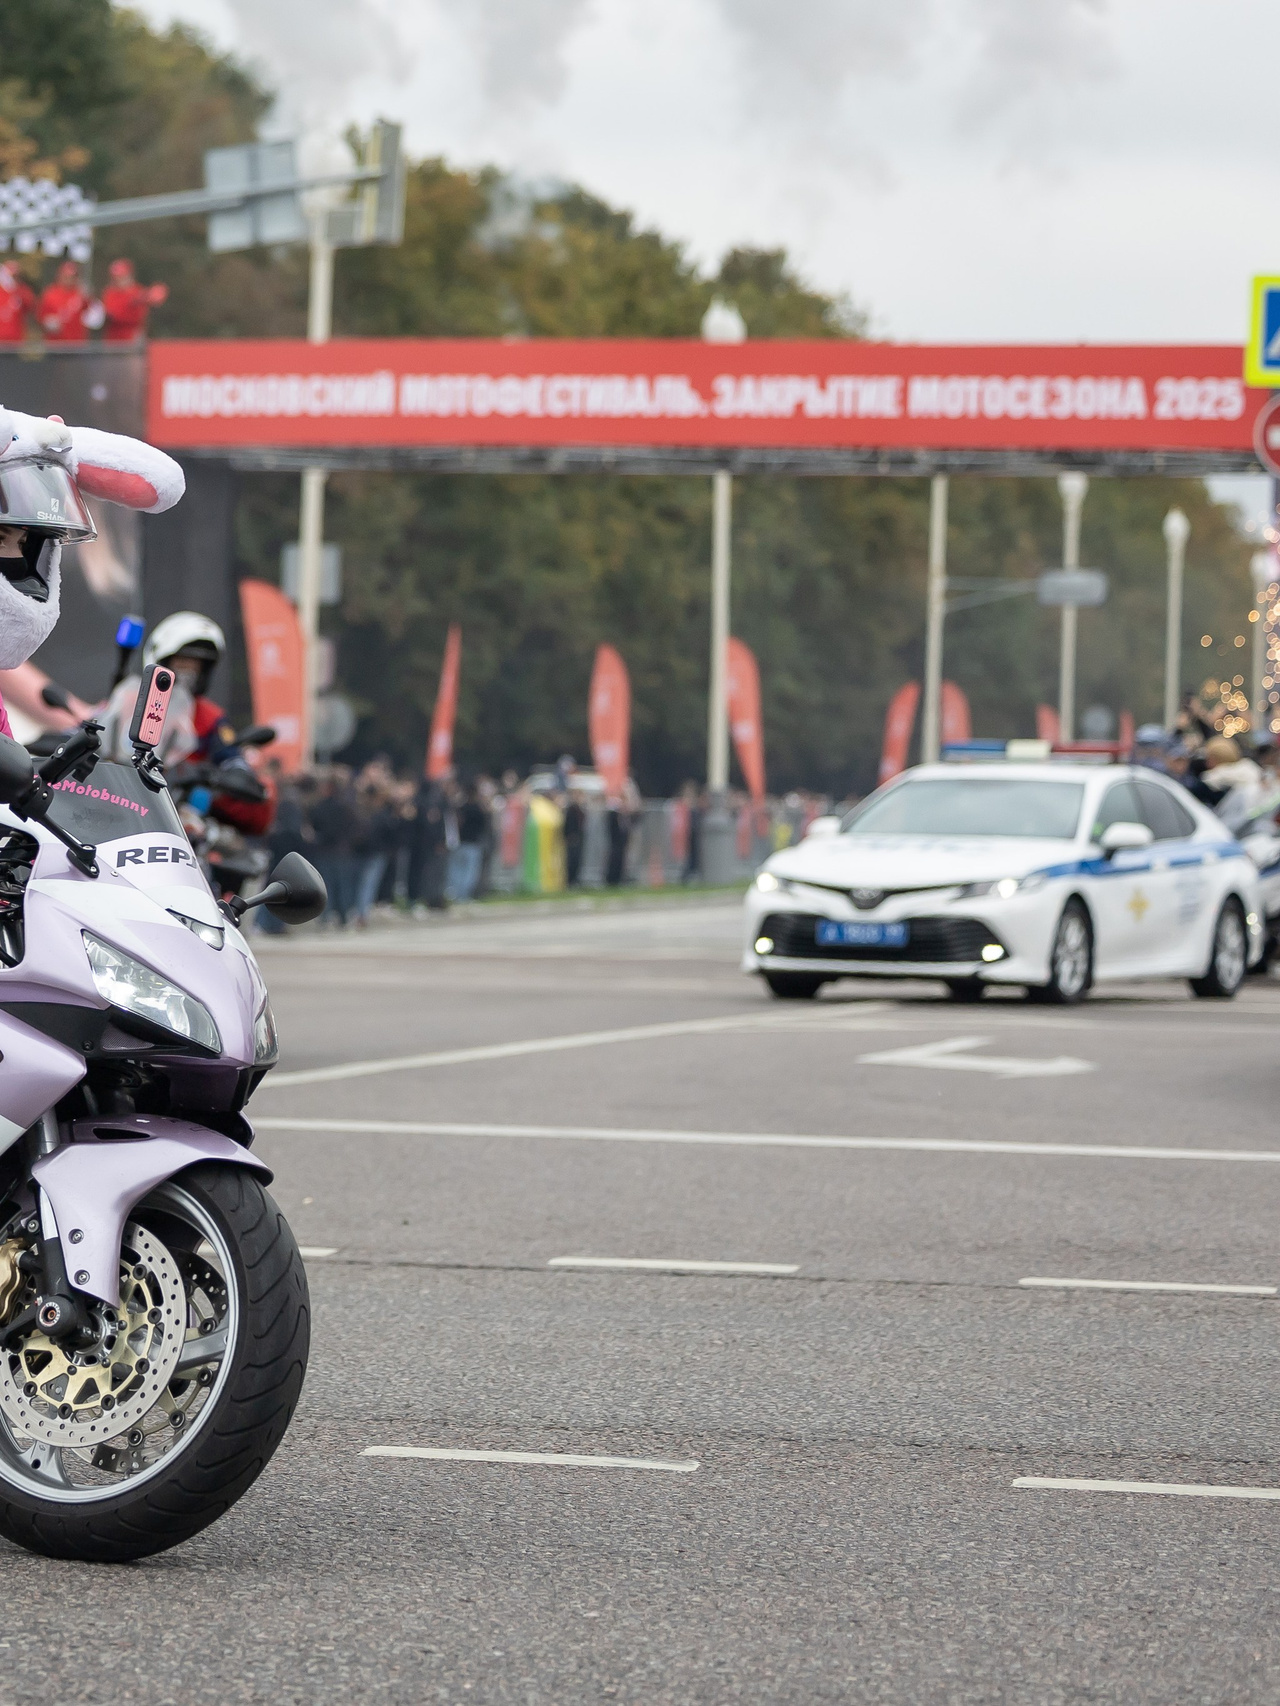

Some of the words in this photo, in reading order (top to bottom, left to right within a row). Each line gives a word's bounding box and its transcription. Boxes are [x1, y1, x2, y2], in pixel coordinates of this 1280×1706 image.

[162, 371, 396, 417] МОСКОВСКИЙ
[711, 374, 902, 418] ЗАКРЫТИЕ
[907, 376, 1147, 419] МОТОСЕЗОНА
[1153, 377, 1243, 421] 2025
